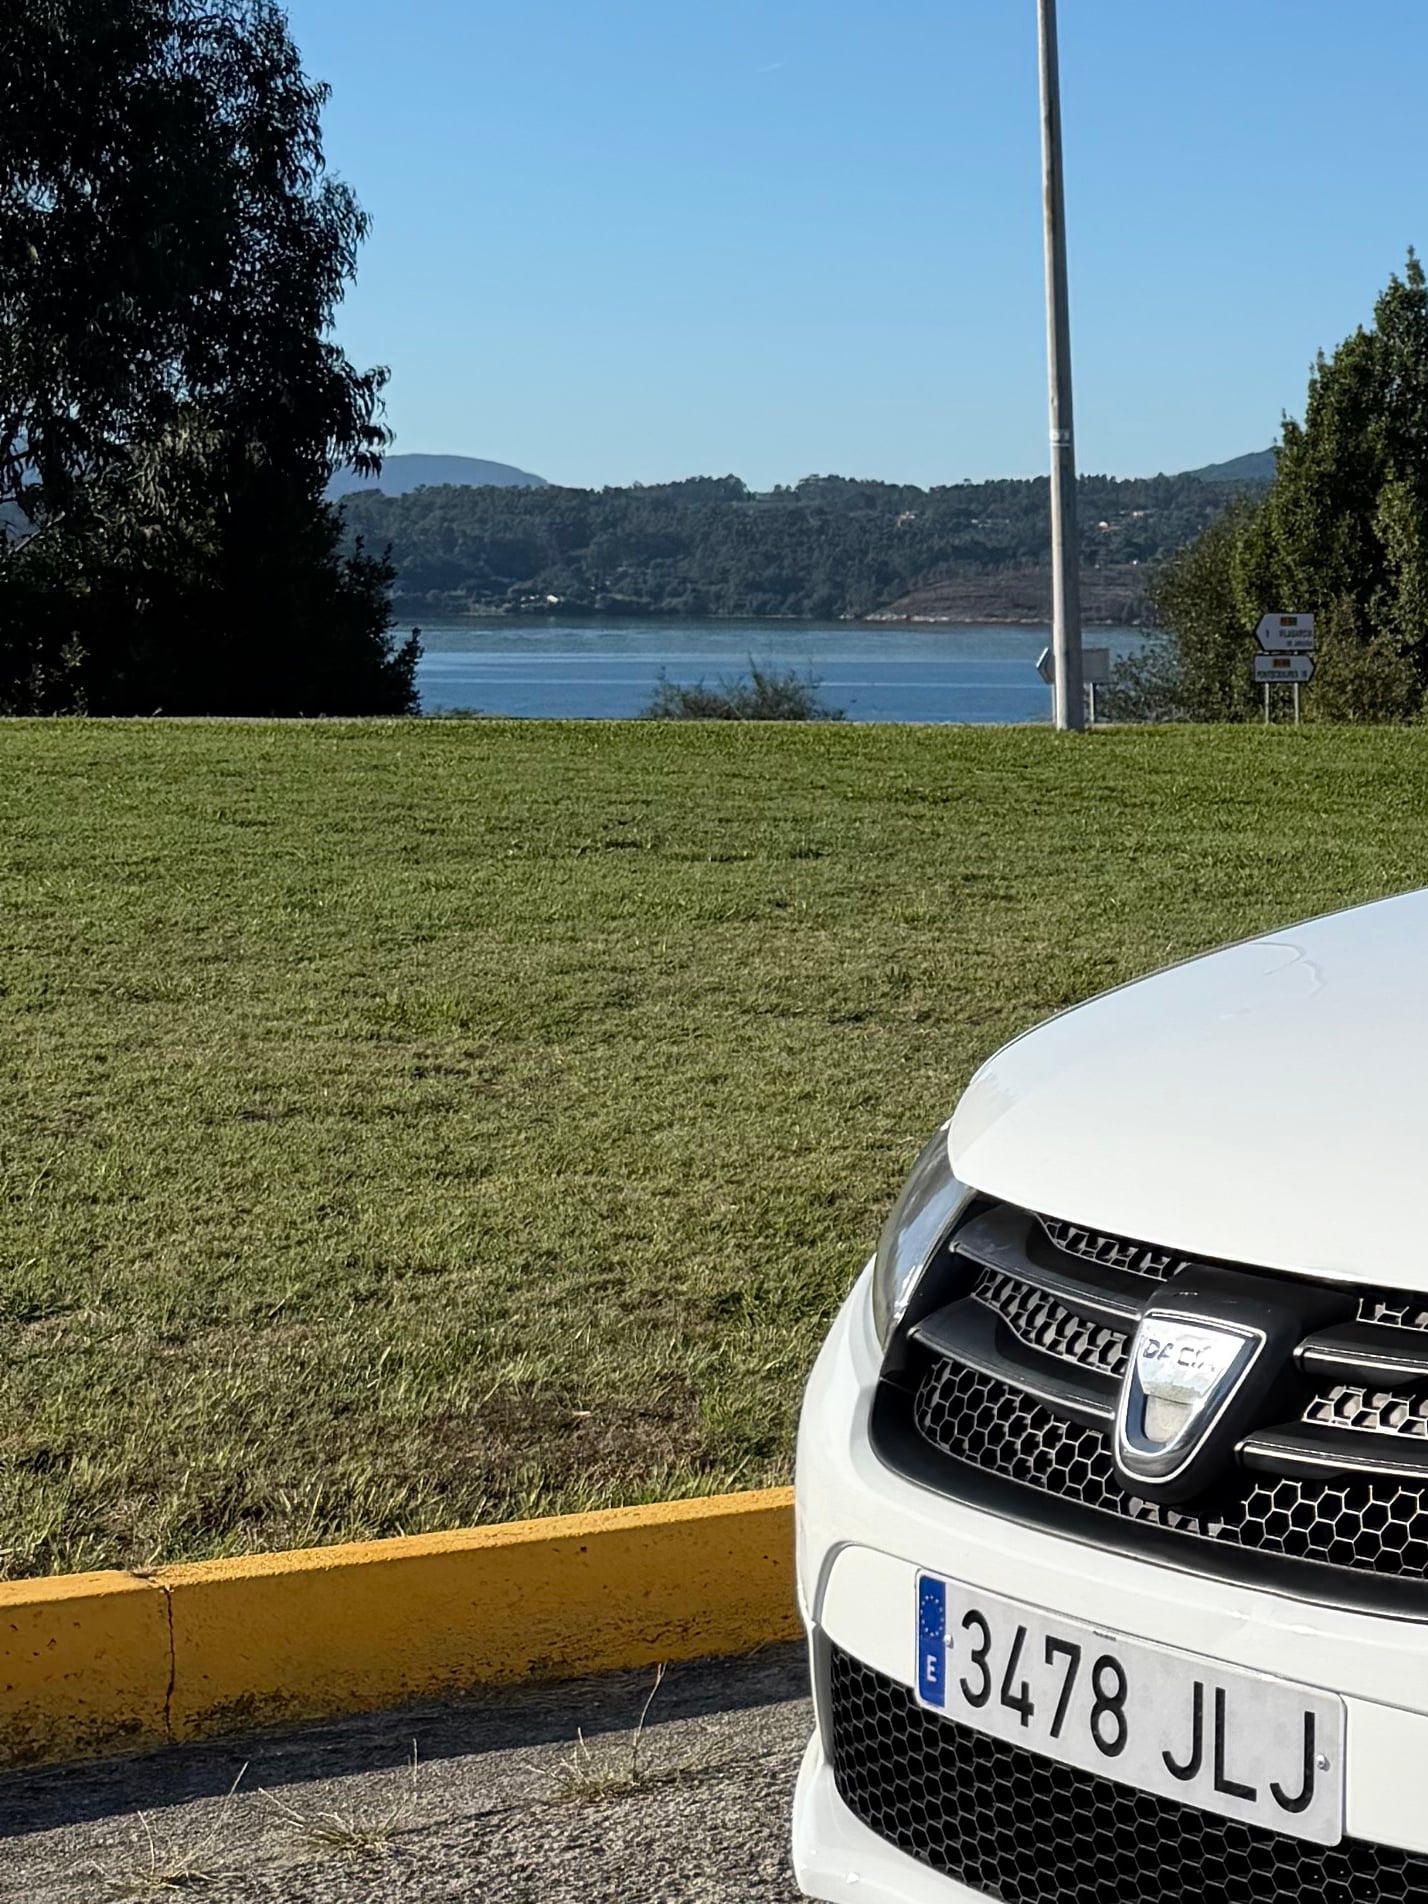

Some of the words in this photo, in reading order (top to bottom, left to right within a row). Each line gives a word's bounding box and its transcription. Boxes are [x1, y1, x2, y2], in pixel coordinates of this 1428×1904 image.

[926, 1654, 937, 1682] E
[959, 1609, 1129, 1757] 3478
[1161, 1680, 1316, 1814] JLJ
